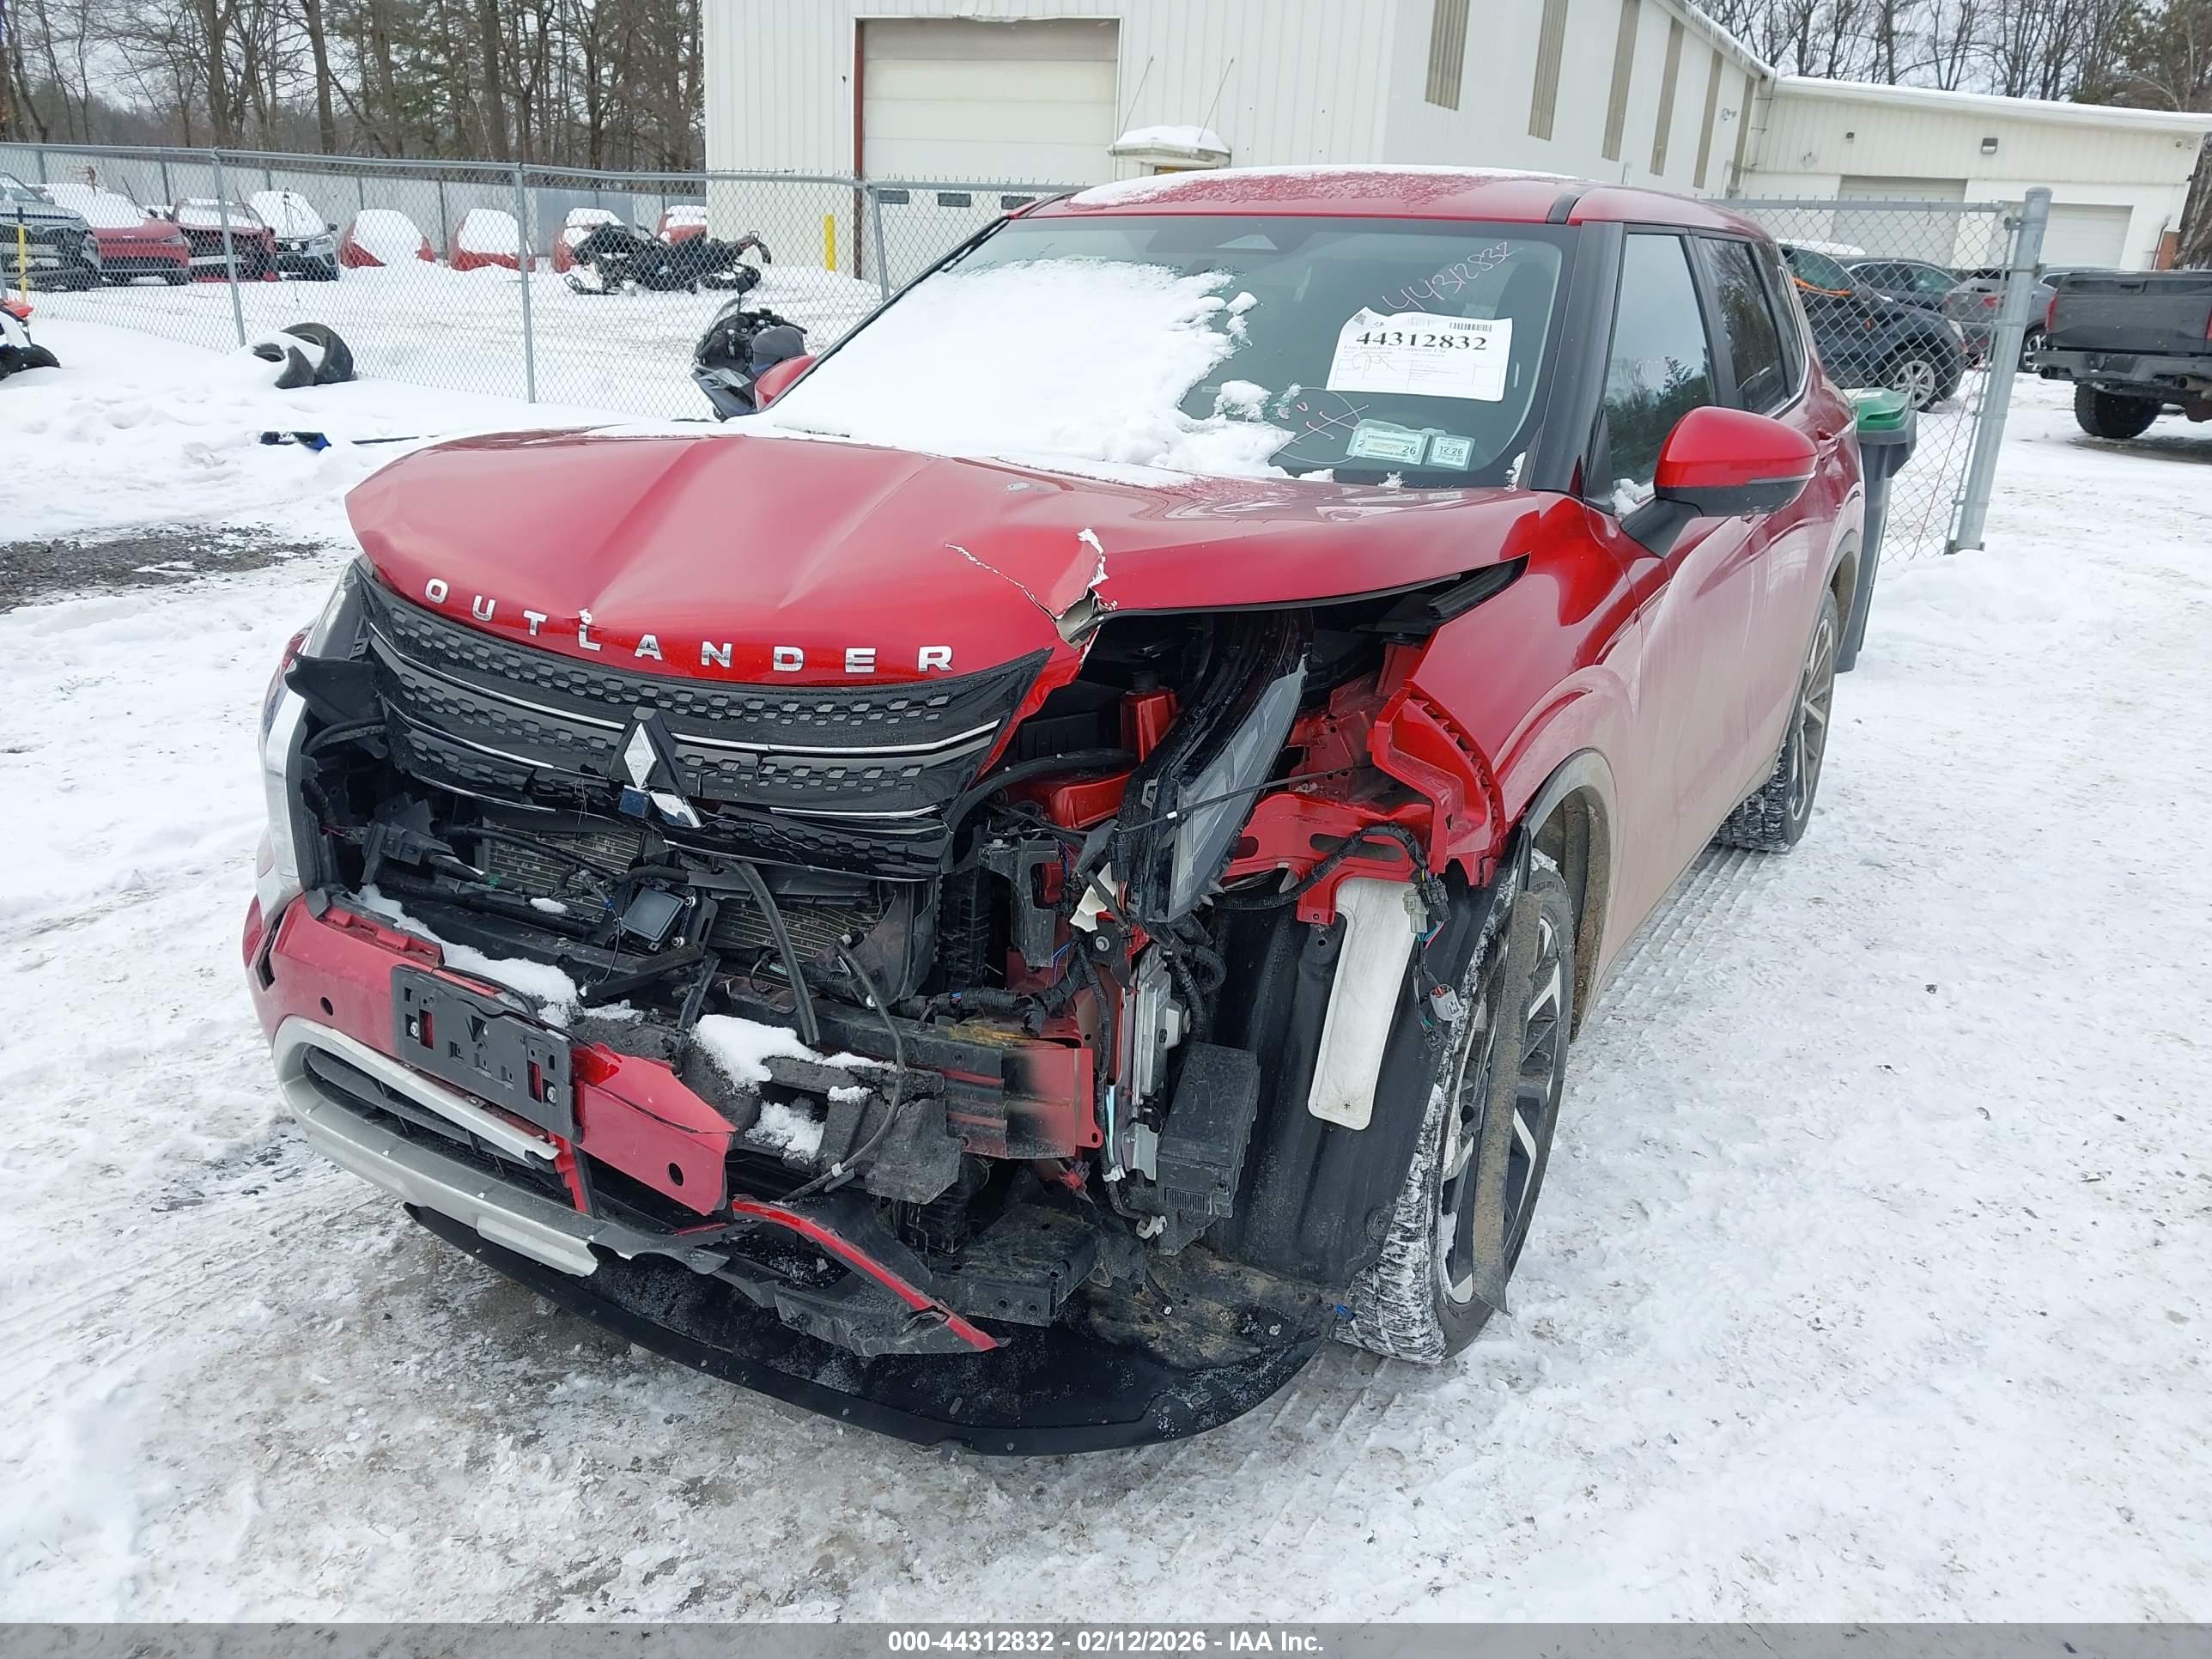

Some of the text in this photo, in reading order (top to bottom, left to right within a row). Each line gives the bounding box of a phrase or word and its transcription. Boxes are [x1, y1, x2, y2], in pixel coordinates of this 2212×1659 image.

[1381, 240, 1523, 311] 44312832
[1355, 331, 1487, 351] 44312832
[1401, 445, 1417, 455] 26
[425, 577, 954, 673] OUTLANDER
